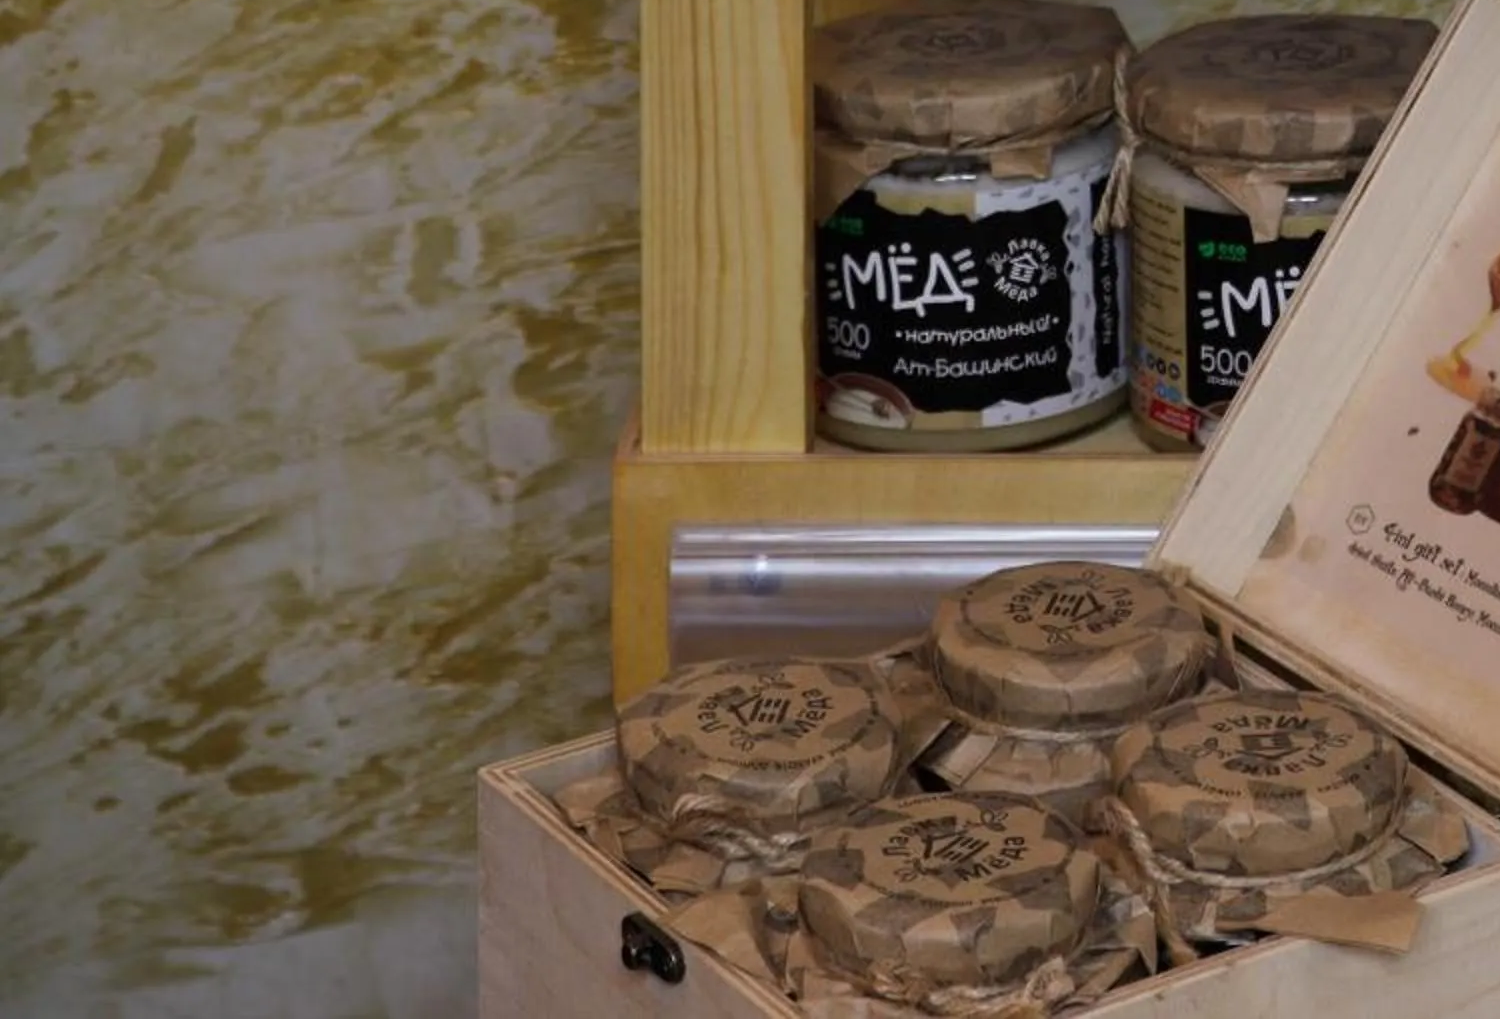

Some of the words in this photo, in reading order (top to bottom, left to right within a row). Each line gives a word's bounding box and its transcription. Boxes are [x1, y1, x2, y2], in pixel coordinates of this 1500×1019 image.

[842, 242, 975, 318] МЁД
[1221, 266, 1301, 338] МЁ
[827, 317, 870, 351] 500
[1200, 346, 1251, 376] 500
[1402, 543, 1442, 563] gift
